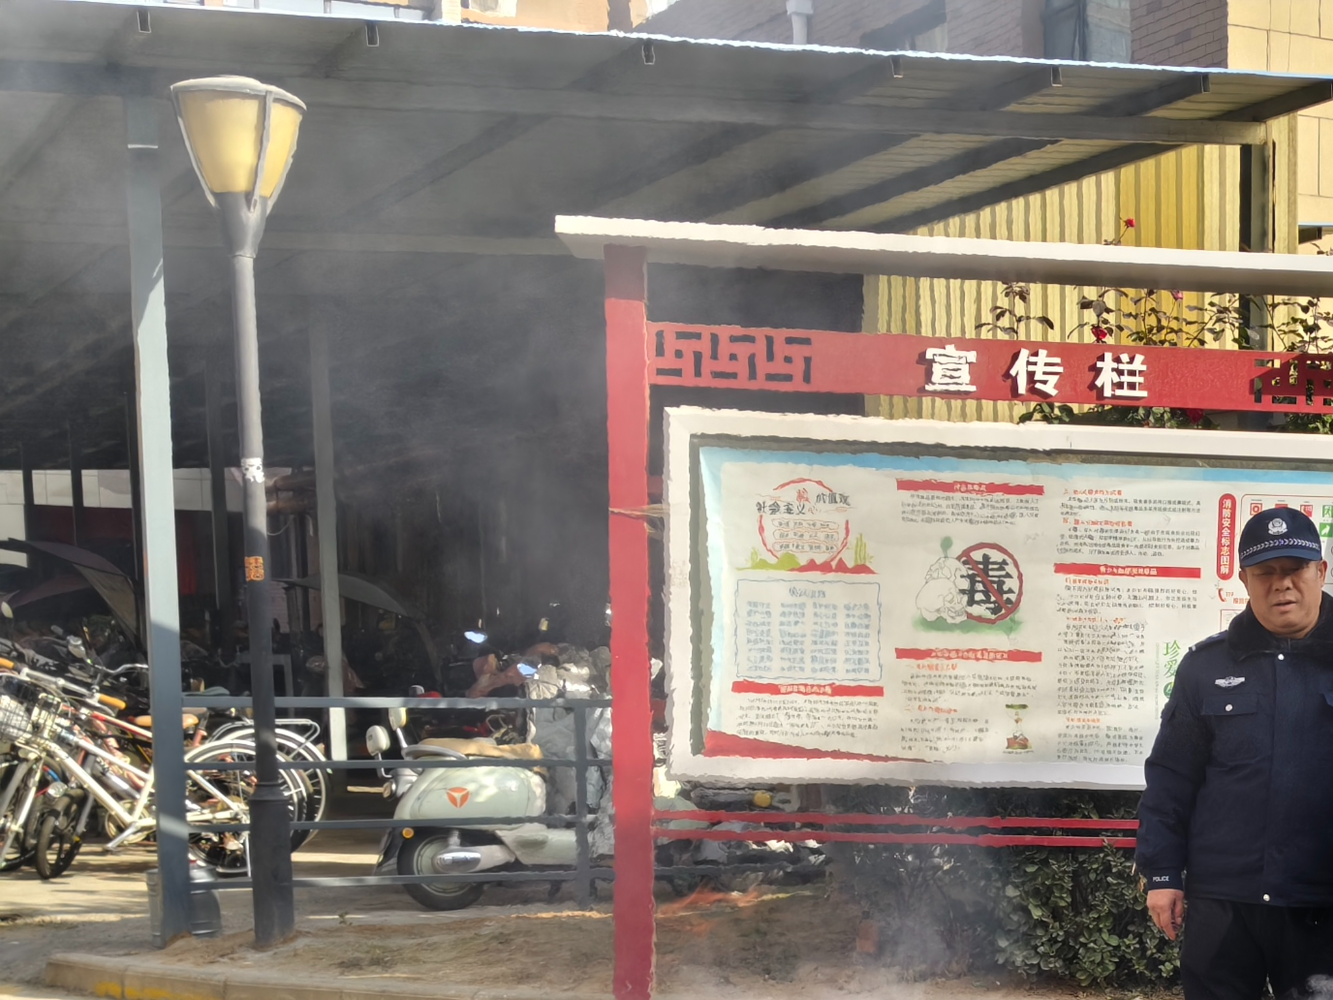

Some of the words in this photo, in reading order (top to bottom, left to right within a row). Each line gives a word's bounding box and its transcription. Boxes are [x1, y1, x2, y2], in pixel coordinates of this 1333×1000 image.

[925, 344, 1148, 398] 宣传栏
[958, 552, 1016, 616] 毒
